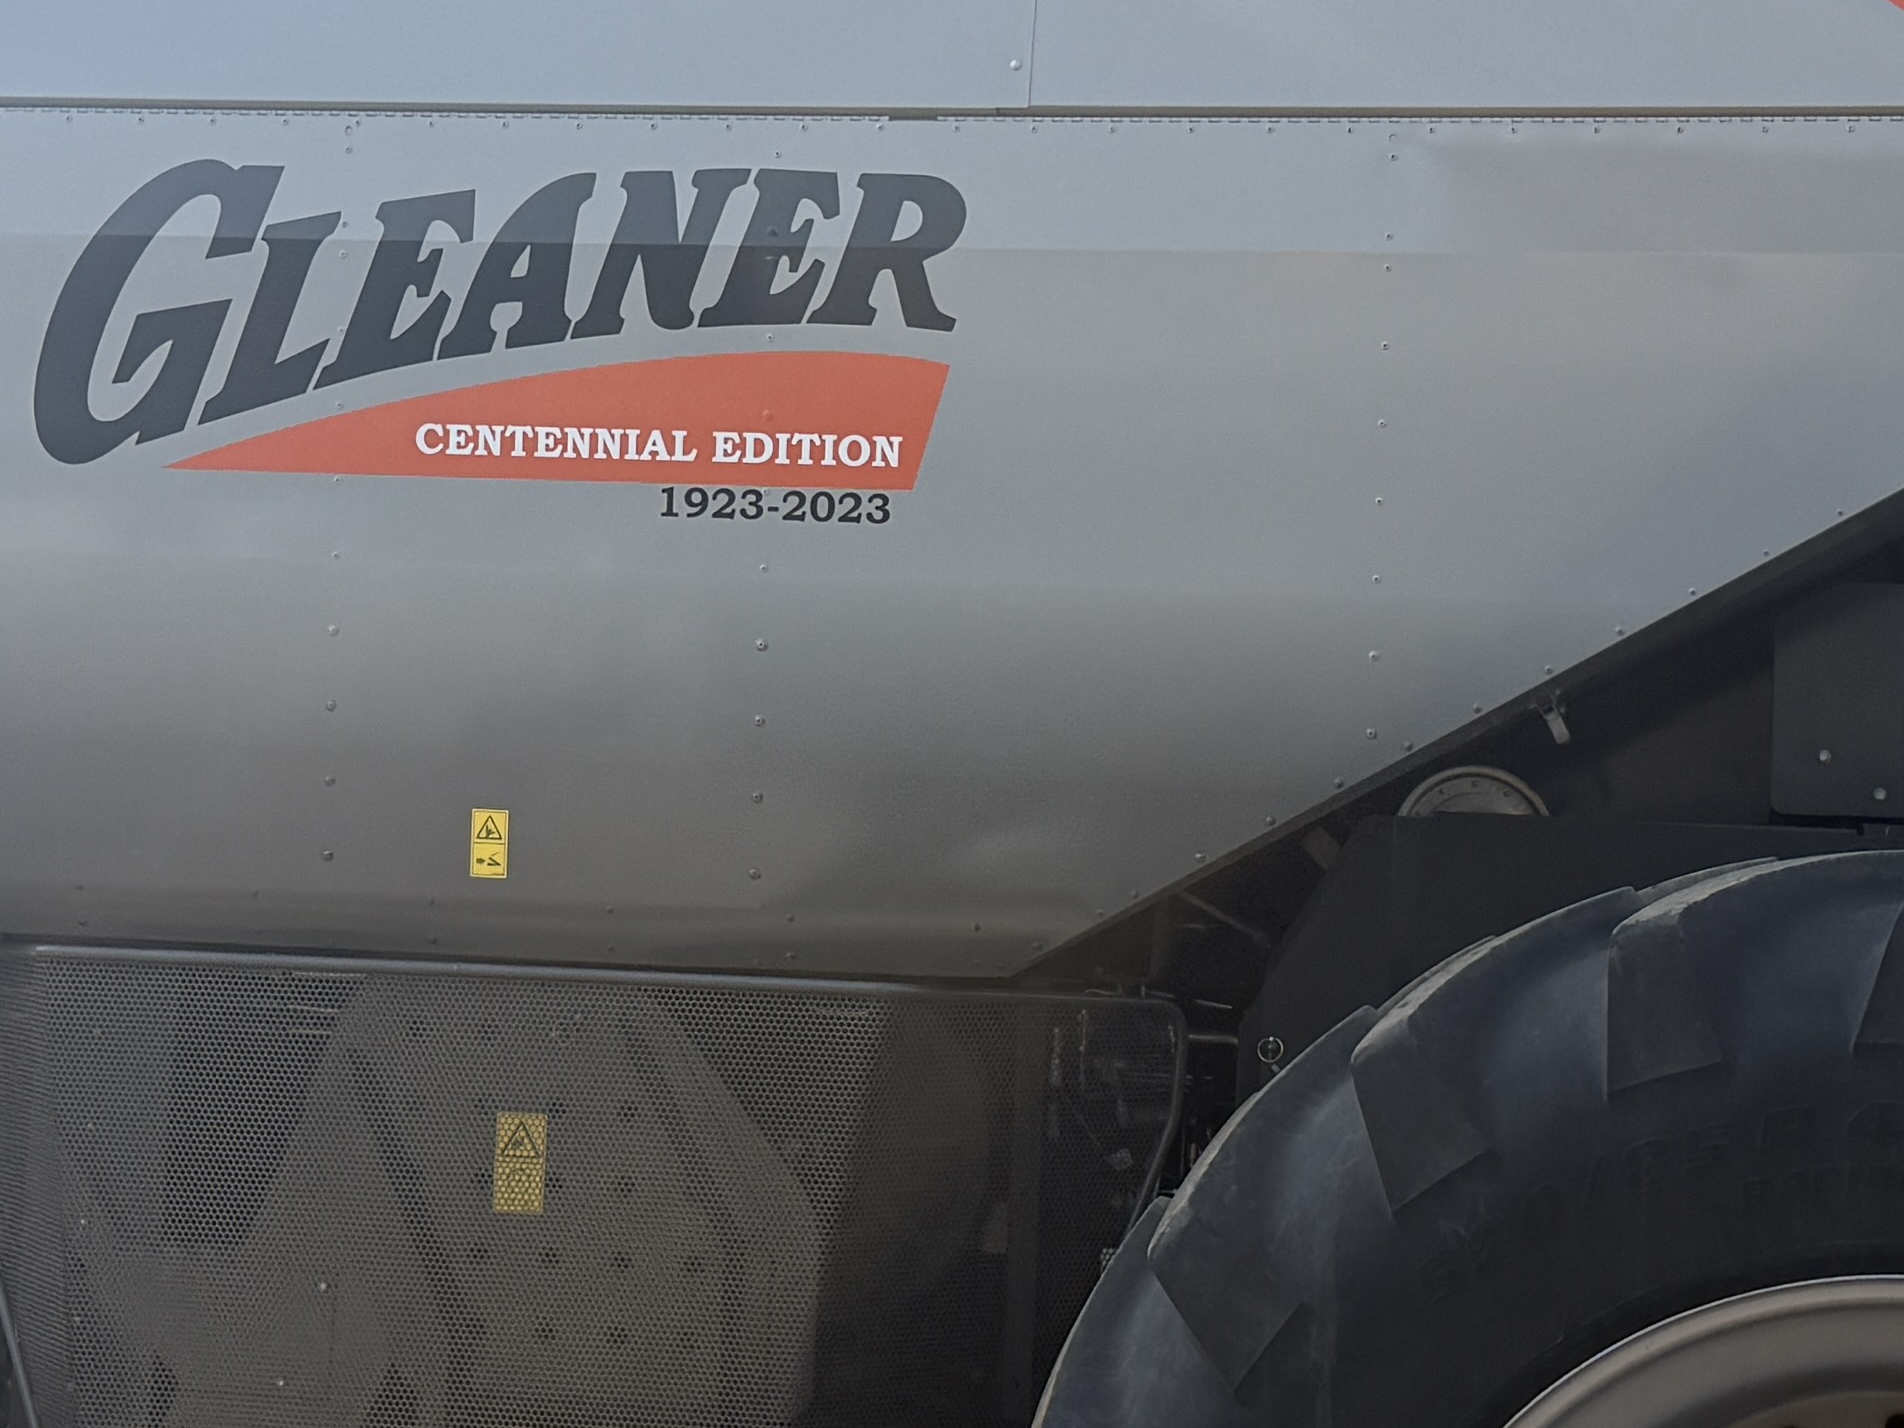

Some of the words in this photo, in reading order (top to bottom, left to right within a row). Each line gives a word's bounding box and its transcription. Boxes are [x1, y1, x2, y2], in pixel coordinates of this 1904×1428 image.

[32, 157, 968, 466] GLEANER
[414, 422, 698, 463] CENTENNIAL
[711, 430, 903, 469] EDITION
[659, 486, 892, 525] 1923-2023
